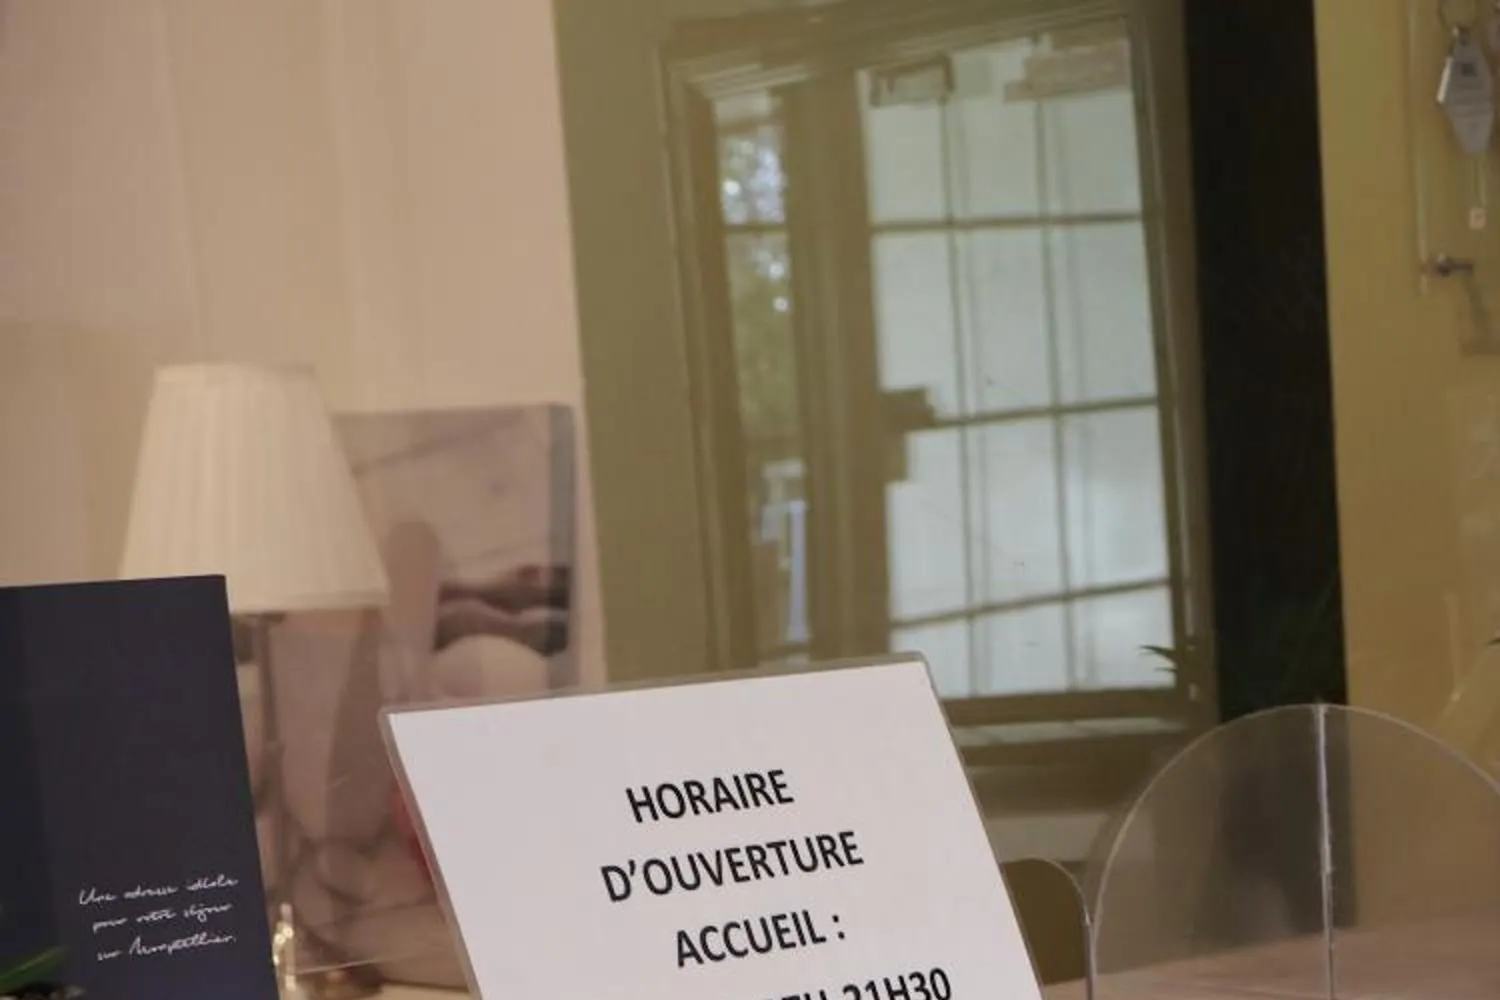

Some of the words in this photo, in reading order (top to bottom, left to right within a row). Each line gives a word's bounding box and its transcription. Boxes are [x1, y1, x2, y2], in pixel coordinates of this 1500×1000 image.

[625, 769, 794, 823] HORAIRE
[600, 831, 864, 902] D'OUVERTURE
[676, 909, 827, 968] ACCUEIL
